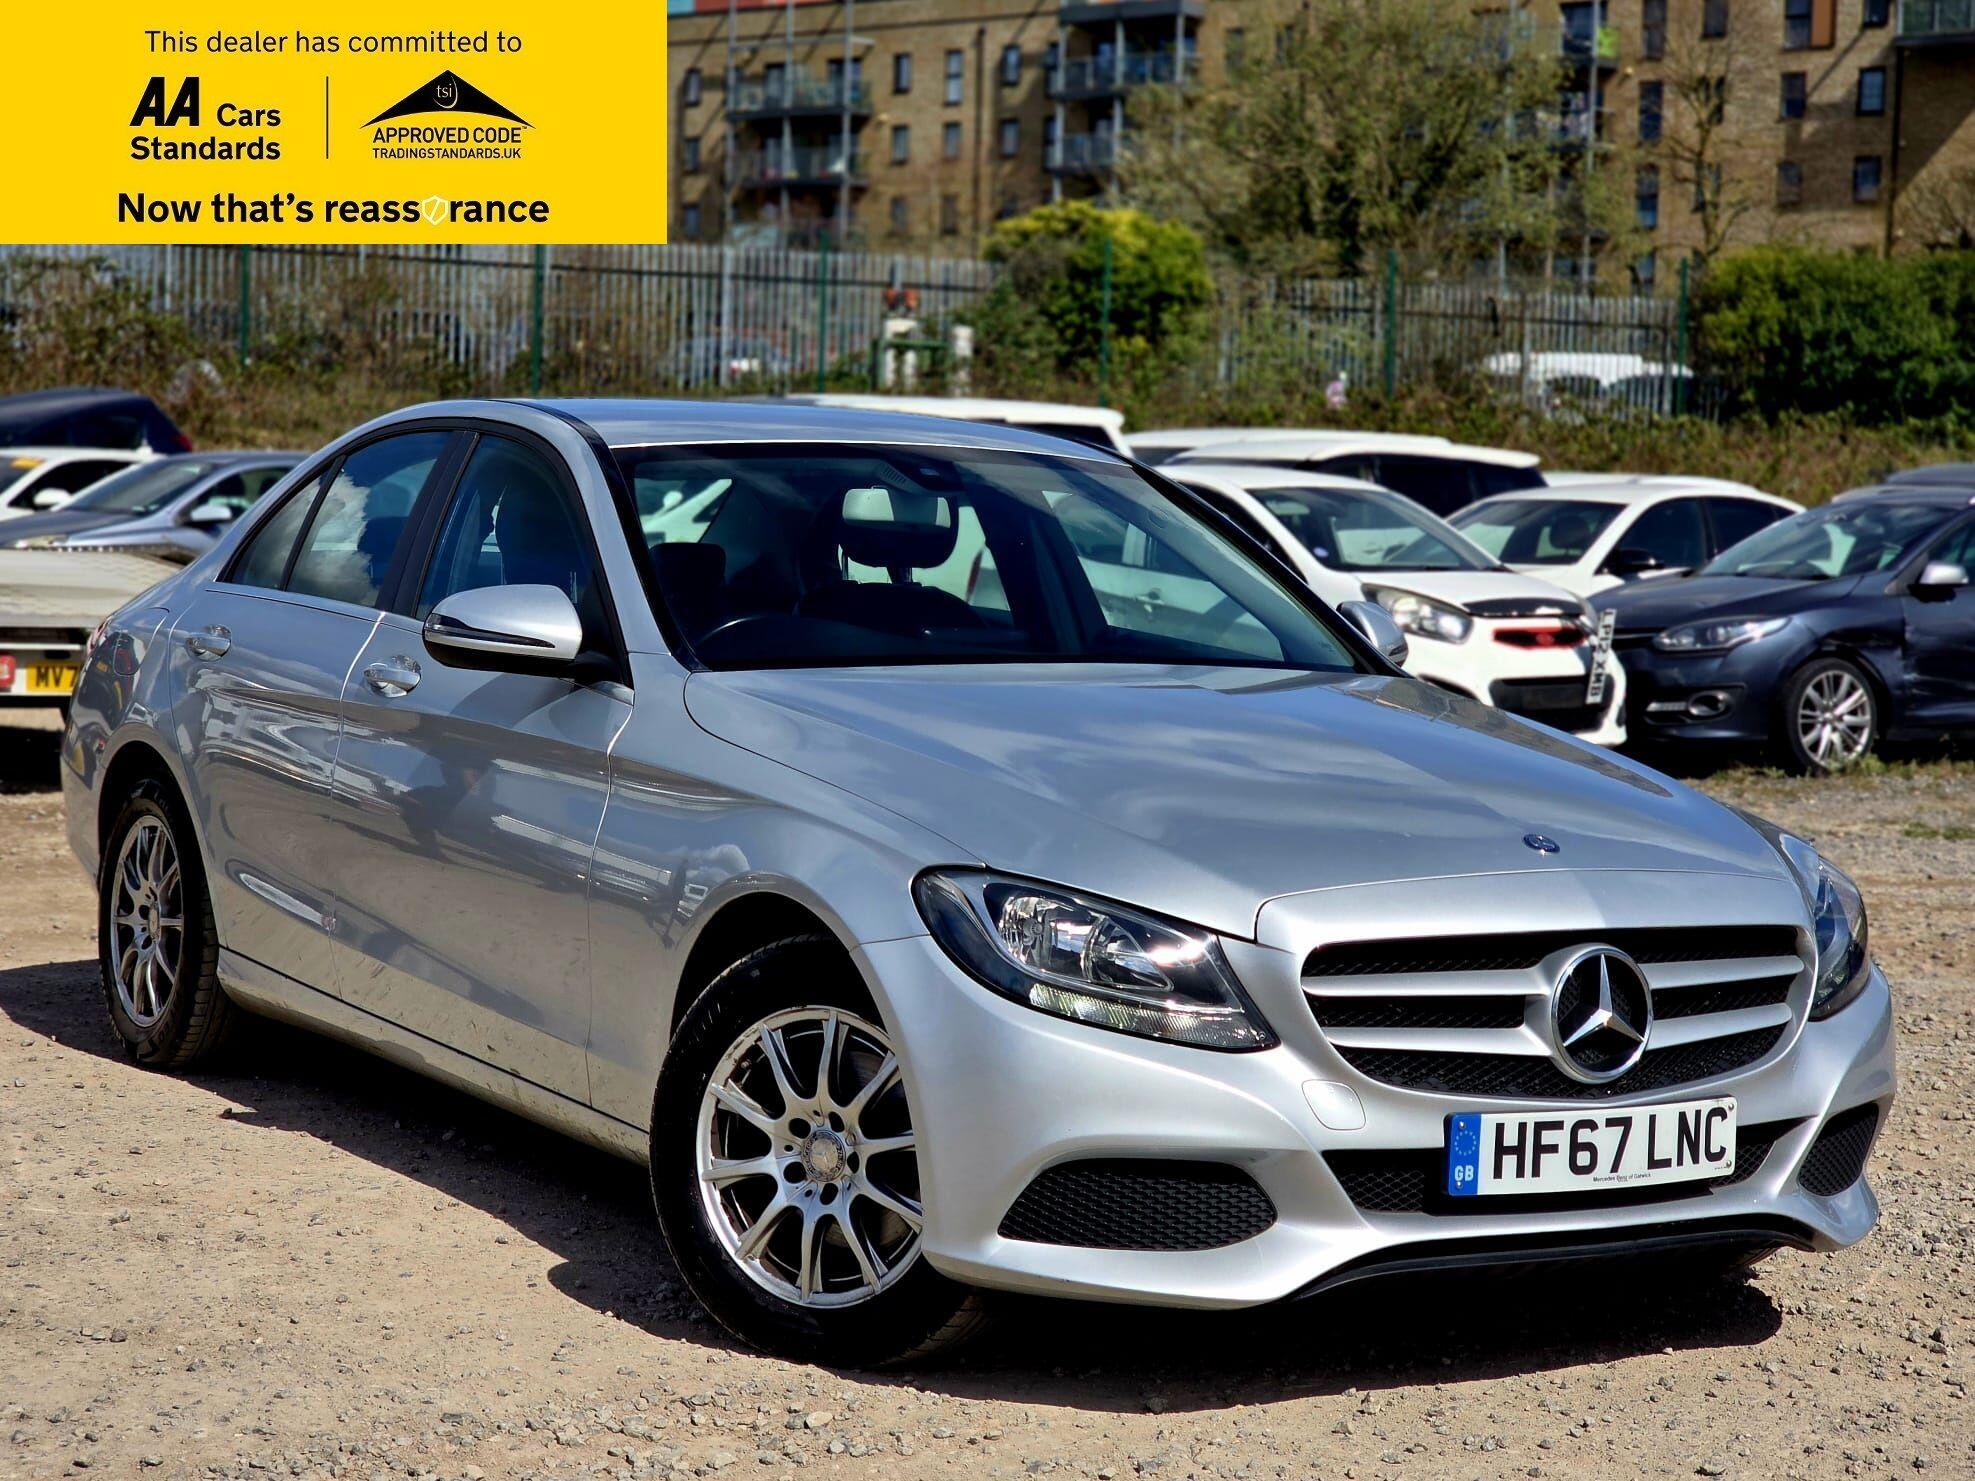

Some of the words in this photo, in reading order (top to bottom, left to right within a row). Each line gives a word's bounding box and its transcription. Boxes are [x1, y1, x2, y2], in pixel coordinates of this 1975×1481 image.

[1493, 1116, 1633, 1180] HF67
[1647, 1107, 1728, 1170] LNC
[1454, 1165, 1474, 1182] GB
